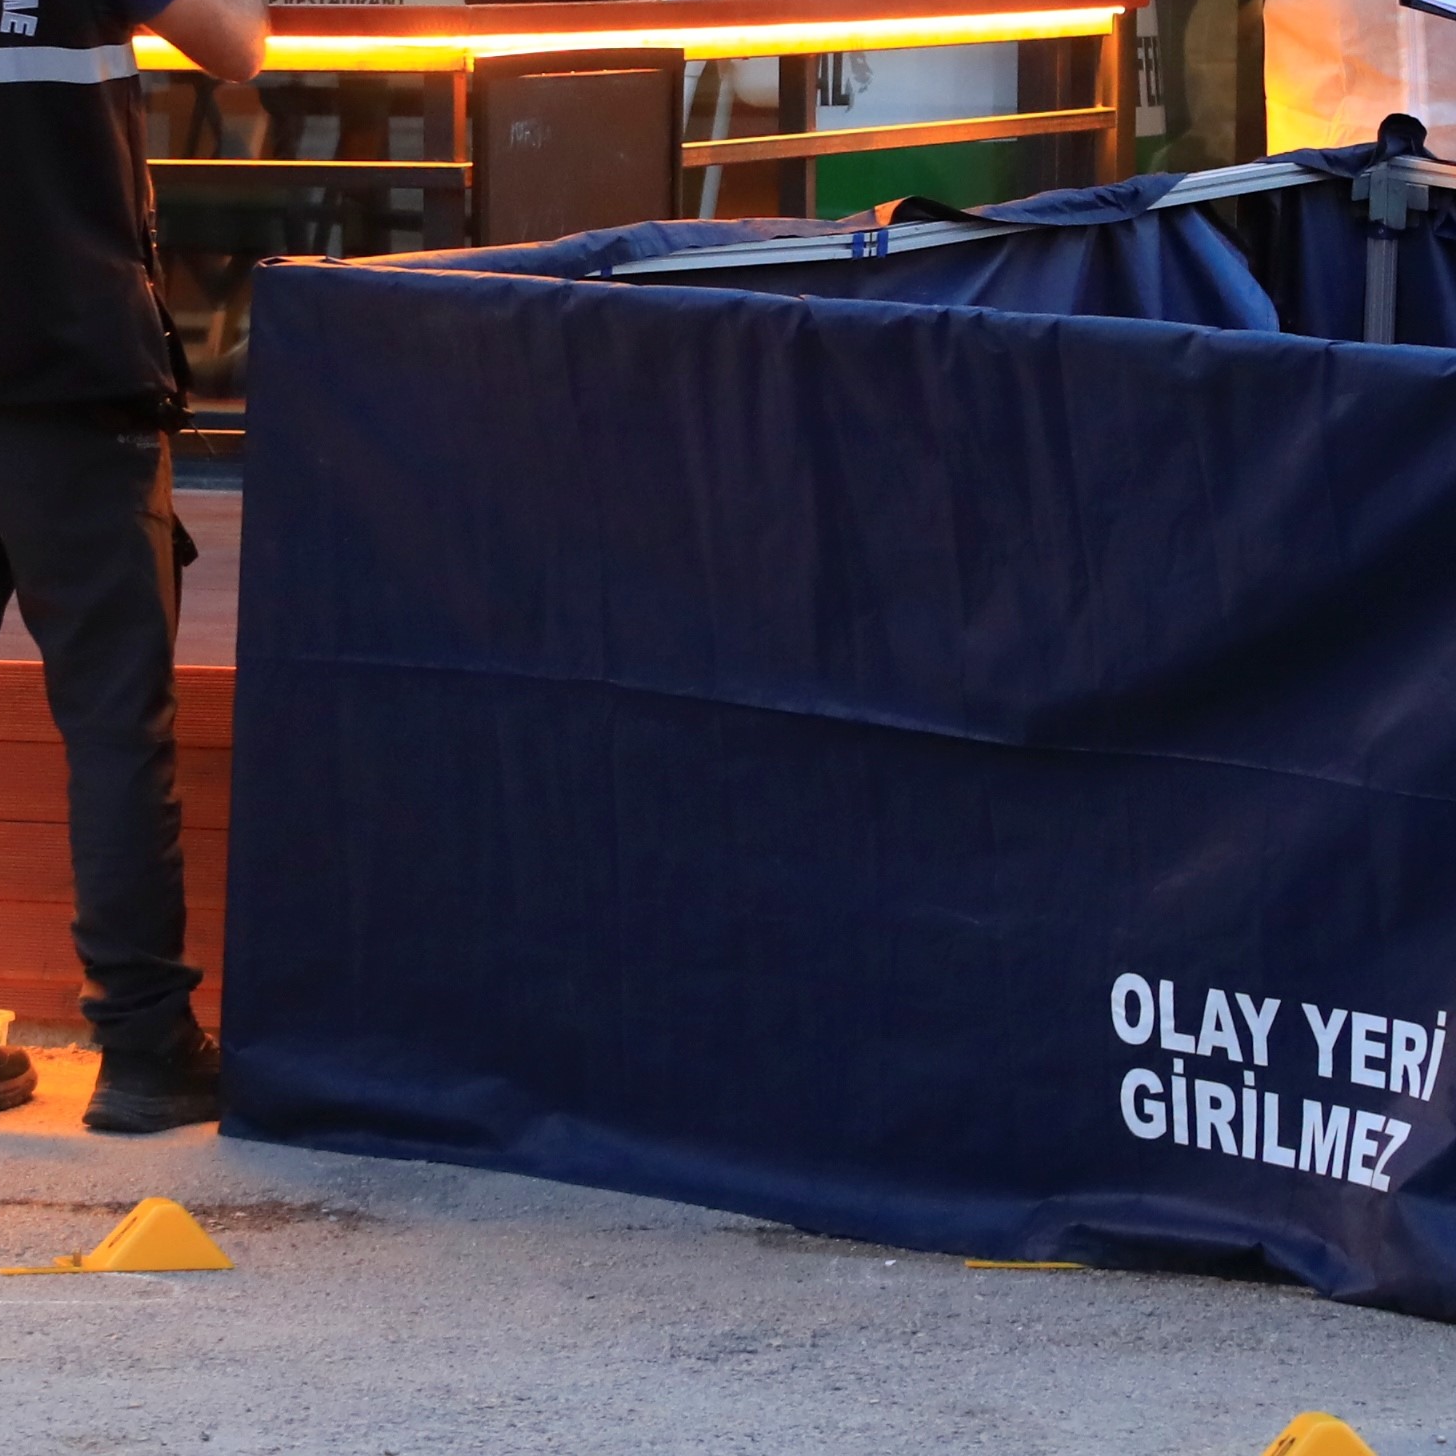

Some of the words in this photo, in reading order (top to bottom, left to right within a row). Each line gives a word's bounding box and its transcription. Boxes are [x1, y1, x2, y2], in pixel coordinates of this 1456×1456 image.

[1111, 972, 1282, 1067] OLAY
[1301, 1003, 1447, 1102] YERİ
[1120, 1057, 1412, 1193] GİRİLMEZ
